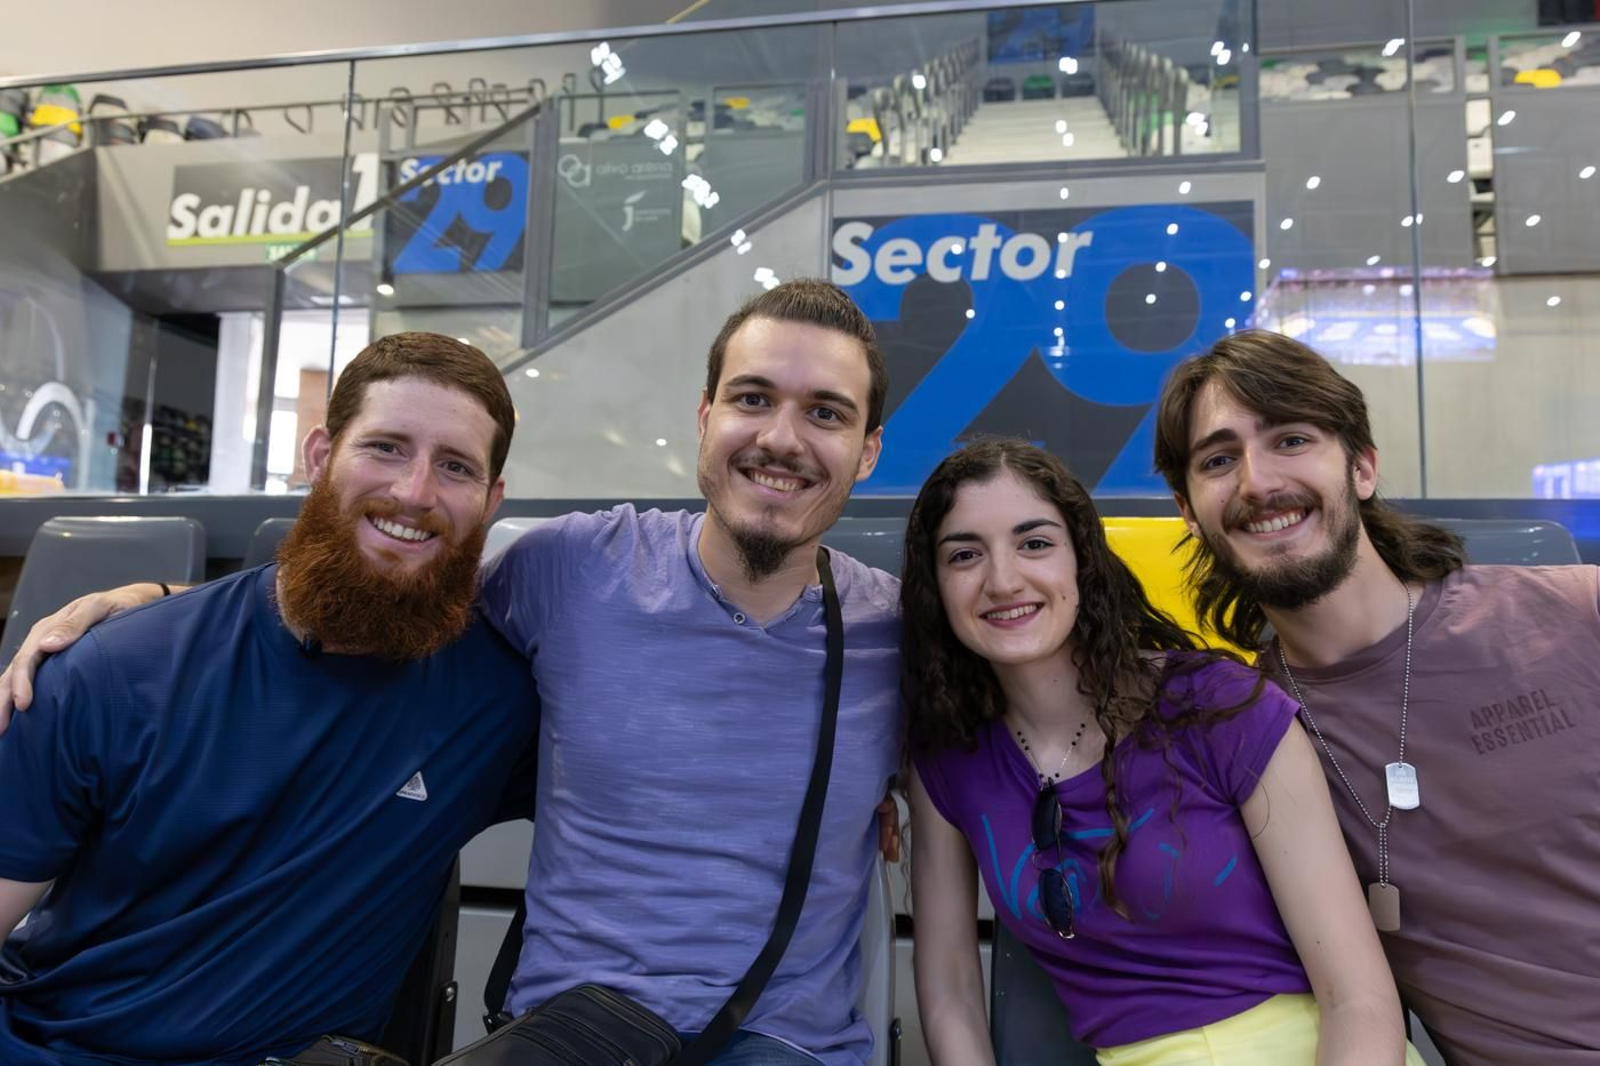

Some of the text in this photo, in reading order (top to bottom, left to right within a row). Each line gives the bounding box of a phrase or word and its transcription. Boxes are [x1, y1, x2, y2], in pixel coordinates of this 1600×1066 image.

[167, 153, 380, 239] Salida 1
[391, 152, 529, 273] 29
[832, 221, 1093, 286] Sector
[832, 205, 1255, 498] 29
[1470, 688, 1557, 730] APPAREL
[1471, 708, 1576, 755] ESSENTIAL
